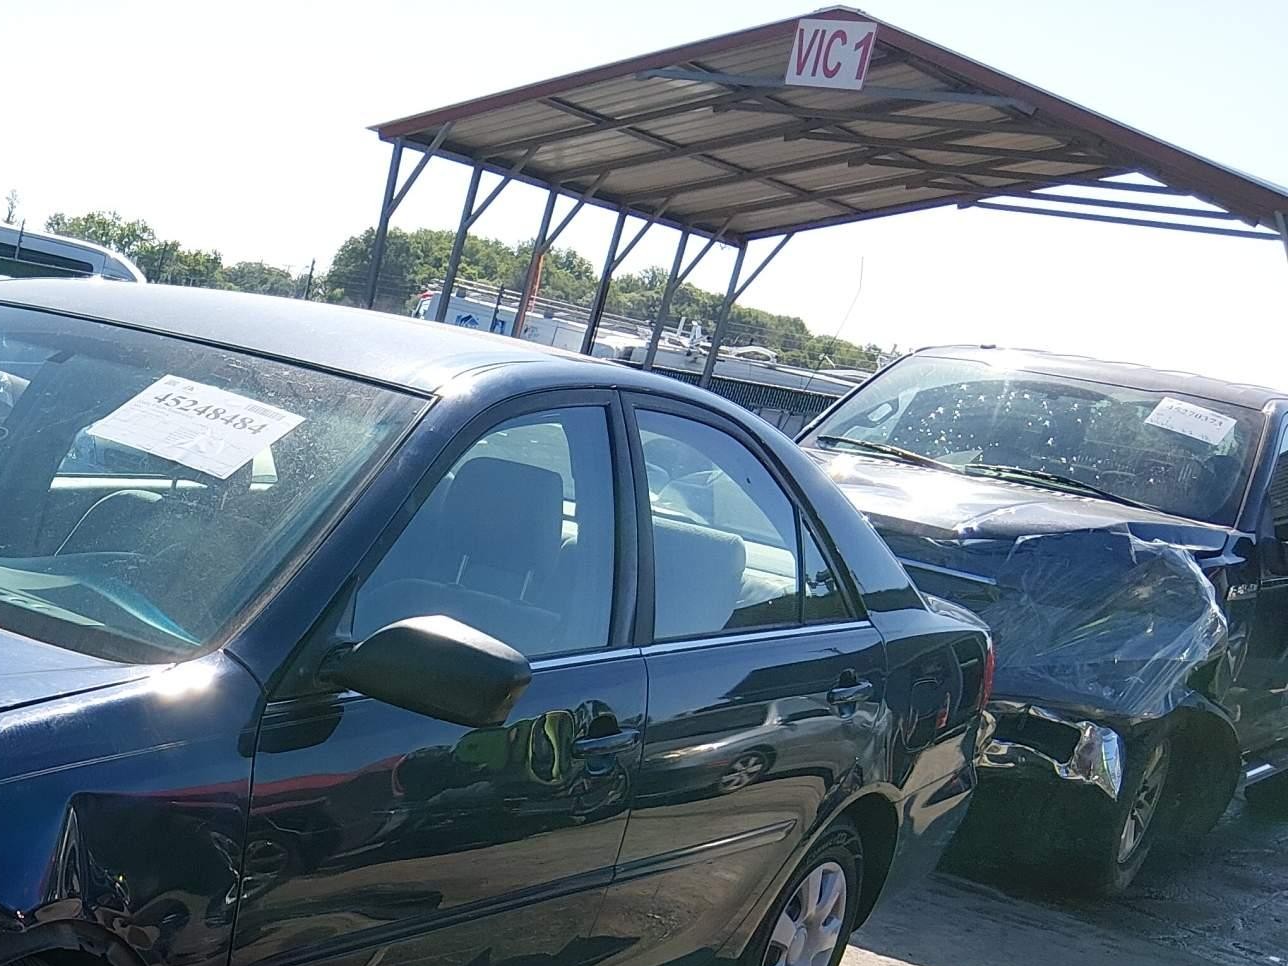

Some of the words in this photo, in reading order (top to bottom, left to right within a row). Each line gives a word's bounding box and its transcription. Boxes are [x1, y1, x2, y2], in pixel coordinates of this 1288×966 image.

[795, 28, 848, 79] VIC
[854, 31, 874, 81] 1
[153, 392, 269, 436] 45248484
